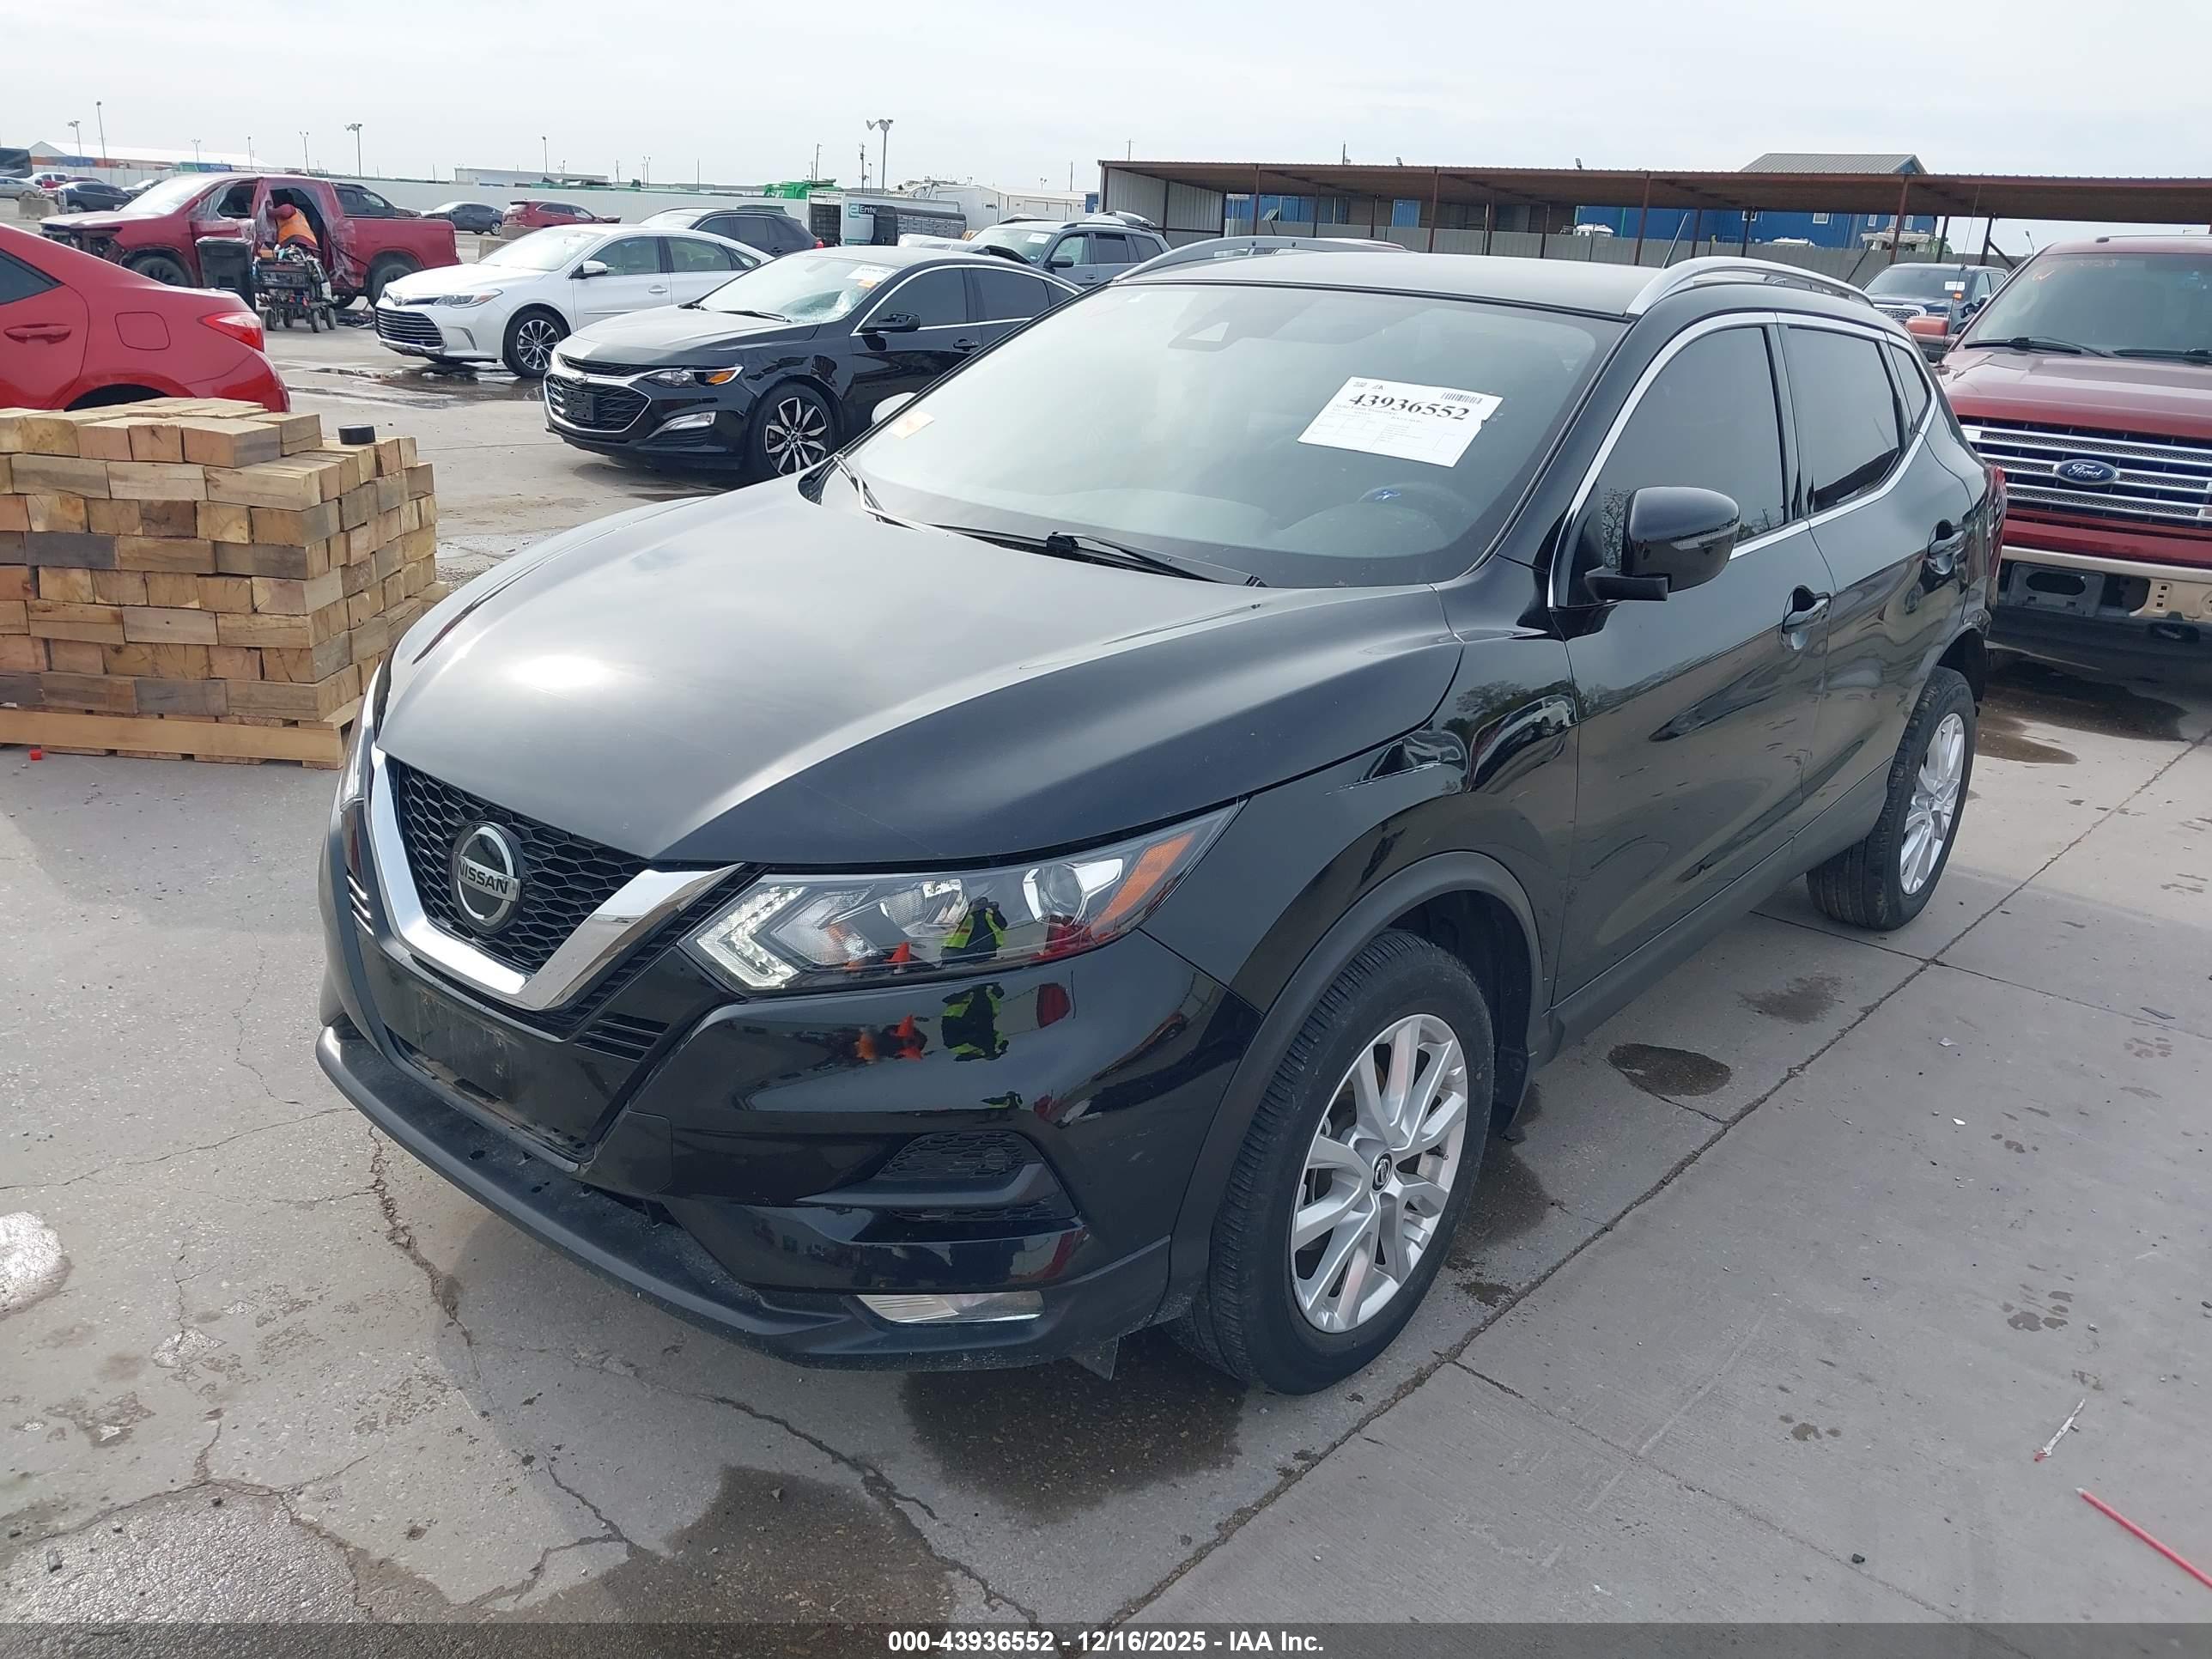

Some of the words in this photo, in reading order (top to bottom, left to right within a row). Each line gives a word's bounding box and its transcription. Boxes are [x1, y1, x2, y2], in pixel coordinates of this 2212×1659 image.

[1349, 393, 1470, 421] 43936552
[2068, 463, 2104, 478] Ford
[459, 860, 508, 894] NISSAN
